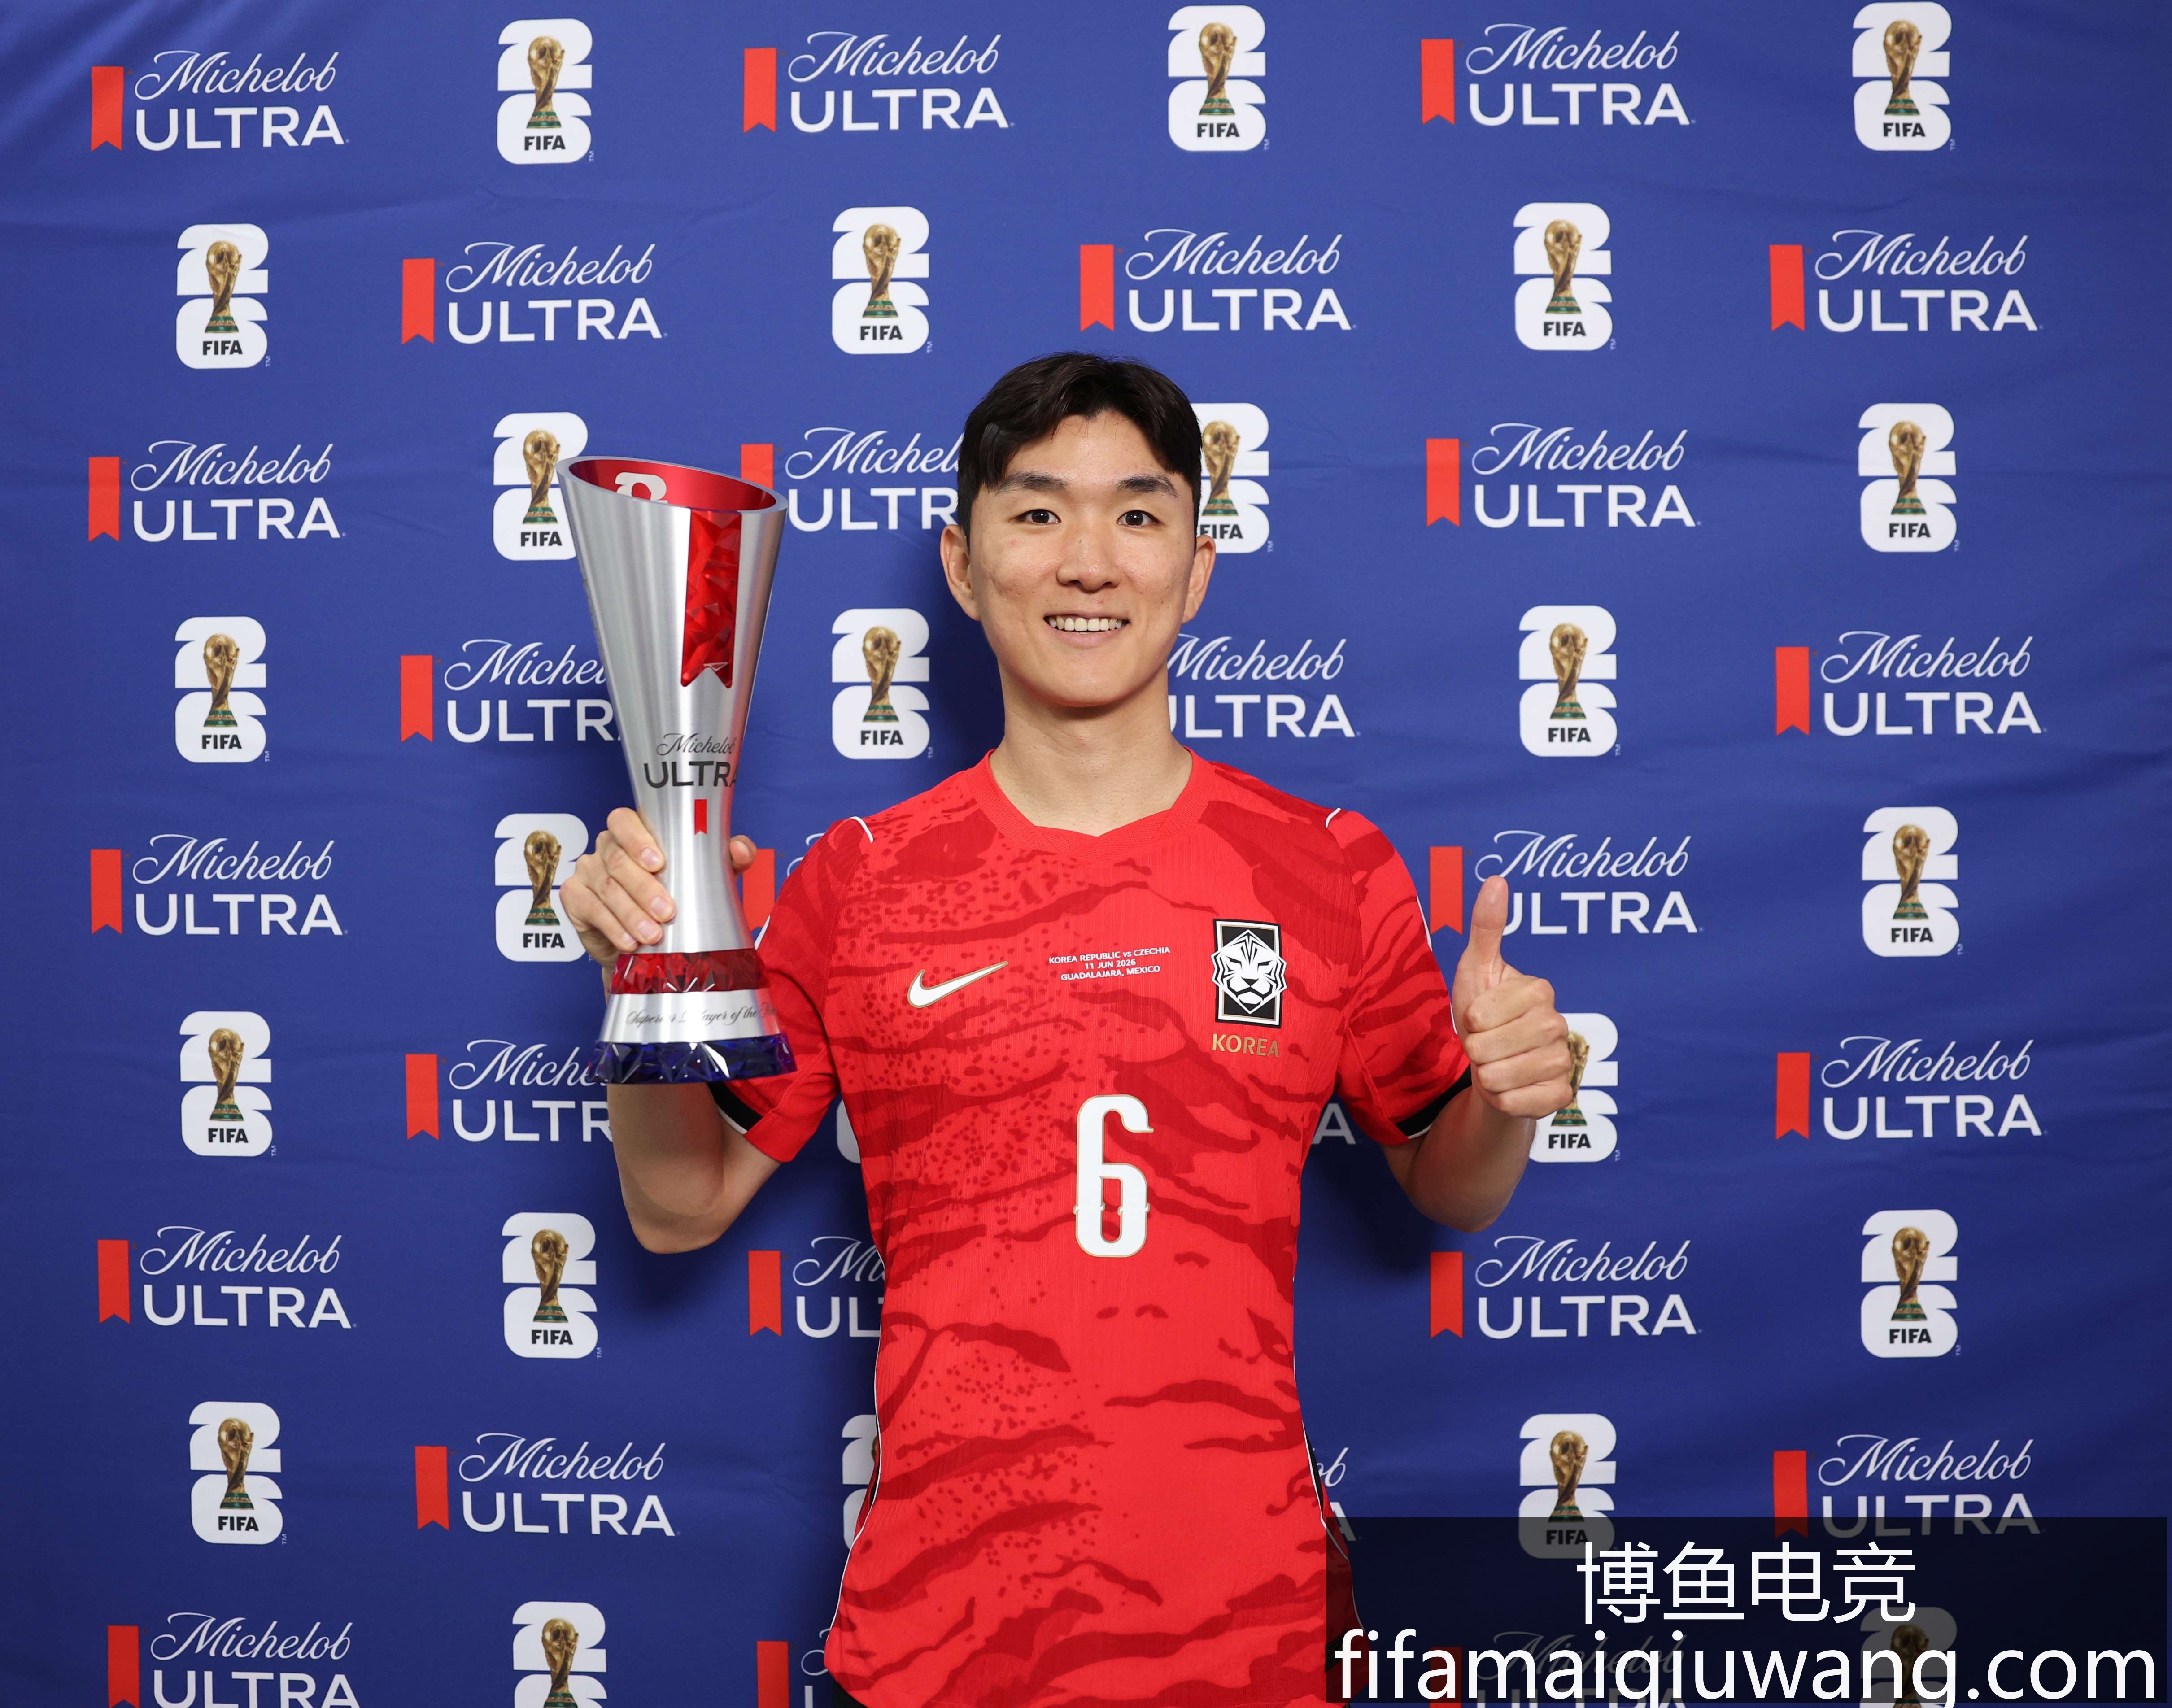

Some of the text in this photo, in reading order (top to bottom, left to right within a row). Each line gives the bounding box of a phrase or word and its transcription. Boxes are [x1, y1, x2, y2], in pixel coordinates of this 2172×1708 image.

[788, 31, 1001, 82] Michelob
[1466, 24, 1679, 74] Michelob
[135, 50, 339, 100] Michelob
[791, 87, 1009, 133] ULTRA
[1470, 83, 1690, 126] ULTRA
[136, 105, 344, 151] ULTRA
[524, 135, 566, 151] FIFA
[1197, 123, 1239, 137] FIFA
[1883, 122, 1925, 137] FIFA
[446, 242, 655, 292] Michelob
[1125, 229, 1342, 280] Michelob
[1815, 230, 2028, 280] Michelob
[449, 298, 662, 344] ULTRA
[1129, 288, 1352, 332] ULTRA
[1544, 322, 1586, 336] FIFA
[1819, 289, 2037, 332] ULTRA
[203, 340, 243, 355] FIFA
[860, 326, 903, 340] FIFA
[131, 440, 333, 491] Michelob
[785, 427, 965, 479] Michel
[1472, 423, 1687, 475] Michelob
[134, 497, 340, 542] ULTRA
[789, 487, 958, 532] ULTR
[1475, 484, 1696, 528] ULTRA
[521, 532, 562, 546] FIFA
[1200, 524, 1243, 539] FIFA
[1889, 523, 1931, 538] FIFA
[445, 639, 606, 691] Miche
[1821, 631, 2032, 683] Michelob
[447, 699, 621, 743] ULTR
[1548, 728, 1591, 742] FIFA
[1824, 692, 2041, 736] ULTRA
[202, 735, 242, 749] FIFA
[861, 730, 903, 745] FIFA
[133, 834, 334, 884] Michelob
[1475, 830, 1691, 882] Michelob
[136, 894, 343, 935] ULTRA
[1891, 928, 1933, 942] FIFA
[523, 933, 565, 948] FIFA
[1049, 956, 1077, 964] KOREA
[1080, 951, 1121, 961] REPUBLIC
[1133, 946, 1170, 956] CZECHIA
[1060, 965, 1160, 980] GUADALAJARA, MEXICO
[1097, 961, 1113, 969] JUN
[1116, 959, 1136, 967] 2026
[626, 1008, 677, 1028] Superir
[1212, 1033, 1279, 1057] KOREA
[1822, 1036, 2033, 1087] Michelob
[208, 1128, 249, 1143] FIFA
[453, 1099, 613, 1142] ULTR
[1824, 1094, 2042, 1140] ULTRA
[1548, 1133, 1591, 1149] FIFA
[1073, 1094, 1154, 1258] 6
[140, 1226, 341, 1275] Michelob
[1476, 1236, 1690, 1287] Michelob
[144, 1285, 351, 1328] ULTRA
[1479, 1294, 1696, 1339] ULTRA
[532, 1329, 573, 1345] FIFA
[1889, 1329, 1932, 1344] FIFA
[459, 1433, 665, 1481] Michelob
[1819, 1434, 2034, 1486] Michelob
[218, 1516, 259, 1531] FIFA
[462, 1491, 675, 1536] ULTRA
[1822, 1493, 2041, 1538] ULTRA
[1546, 1530, 1588, 1545] FIFA
[151, 1612, 353, 1660] Michelob
[154, 1670, 361, 1708] ULTRA
